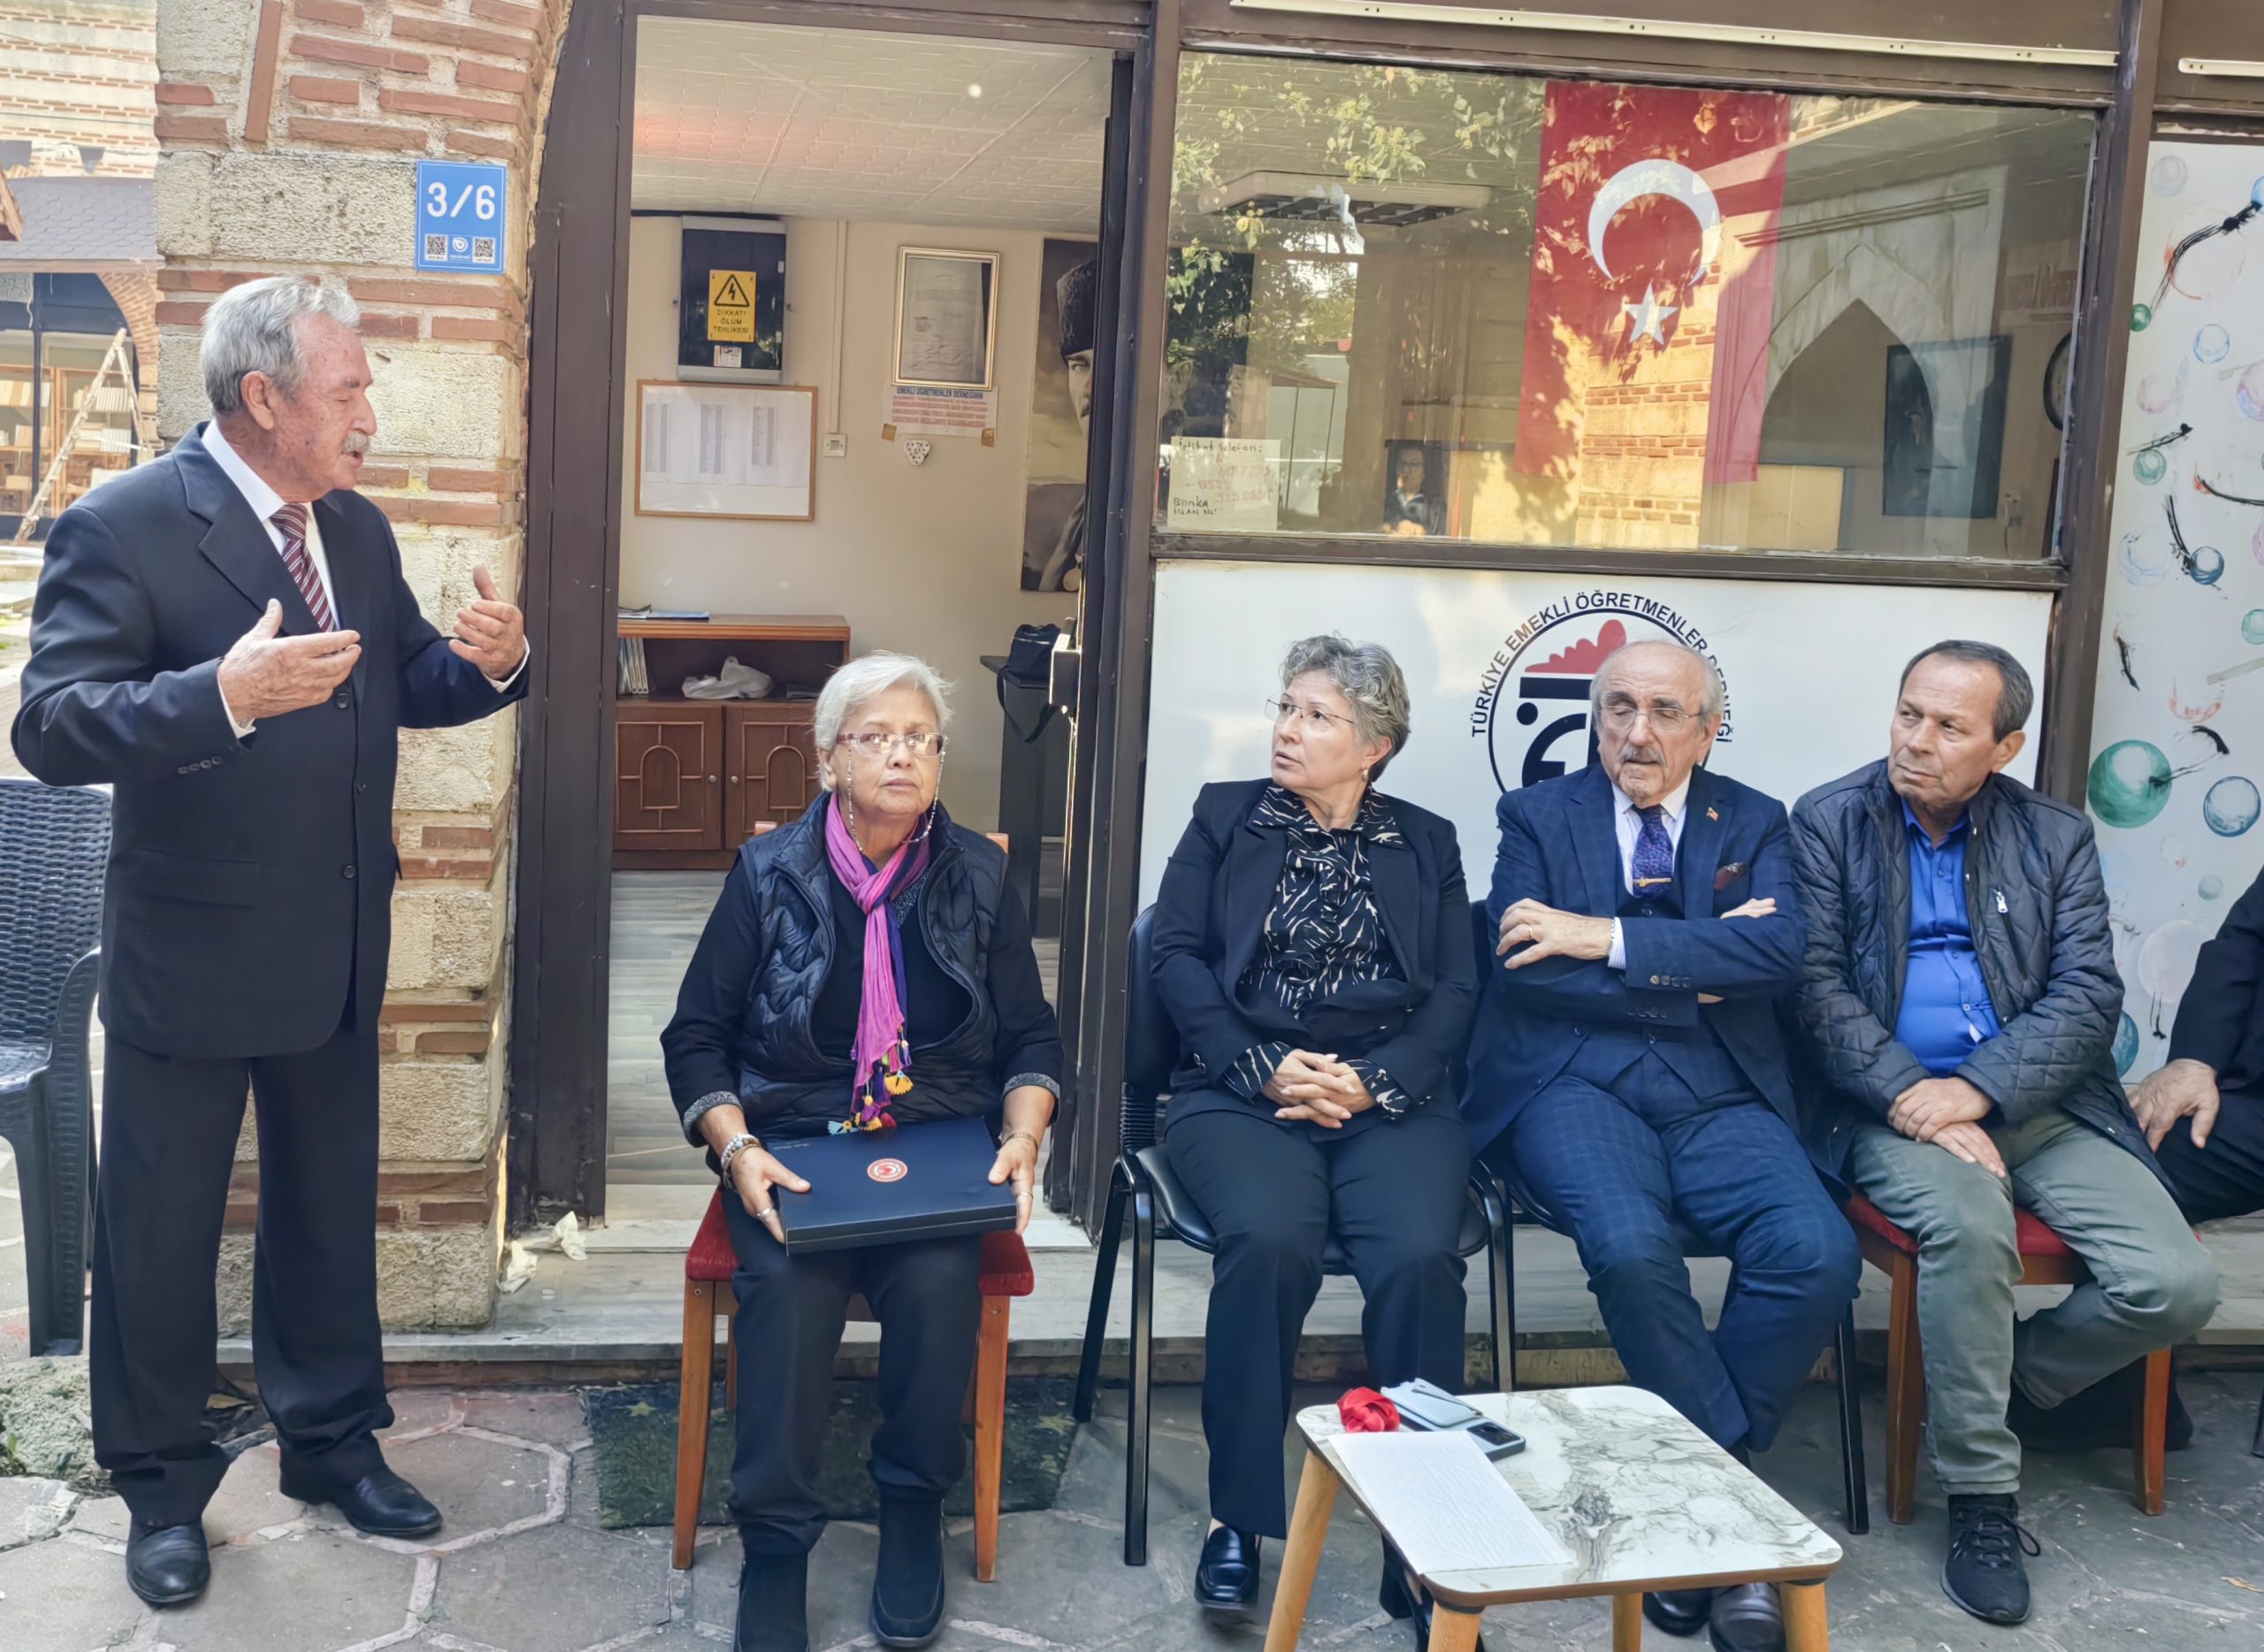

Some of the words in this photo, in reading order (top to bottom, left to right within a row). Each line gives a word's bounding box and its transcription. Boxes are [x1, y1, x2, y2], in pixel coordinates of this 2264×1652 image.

[426, 181, 496, 220] 3/6
[1470, 650, 1511, 738] TÜRKİYE
[1505, 596, 1571, 652] EMEKLİ
[1575, 589, 1708, 653] ÖĞRETMENLER
[1709, 654, 1734, 743] DEĞİ
